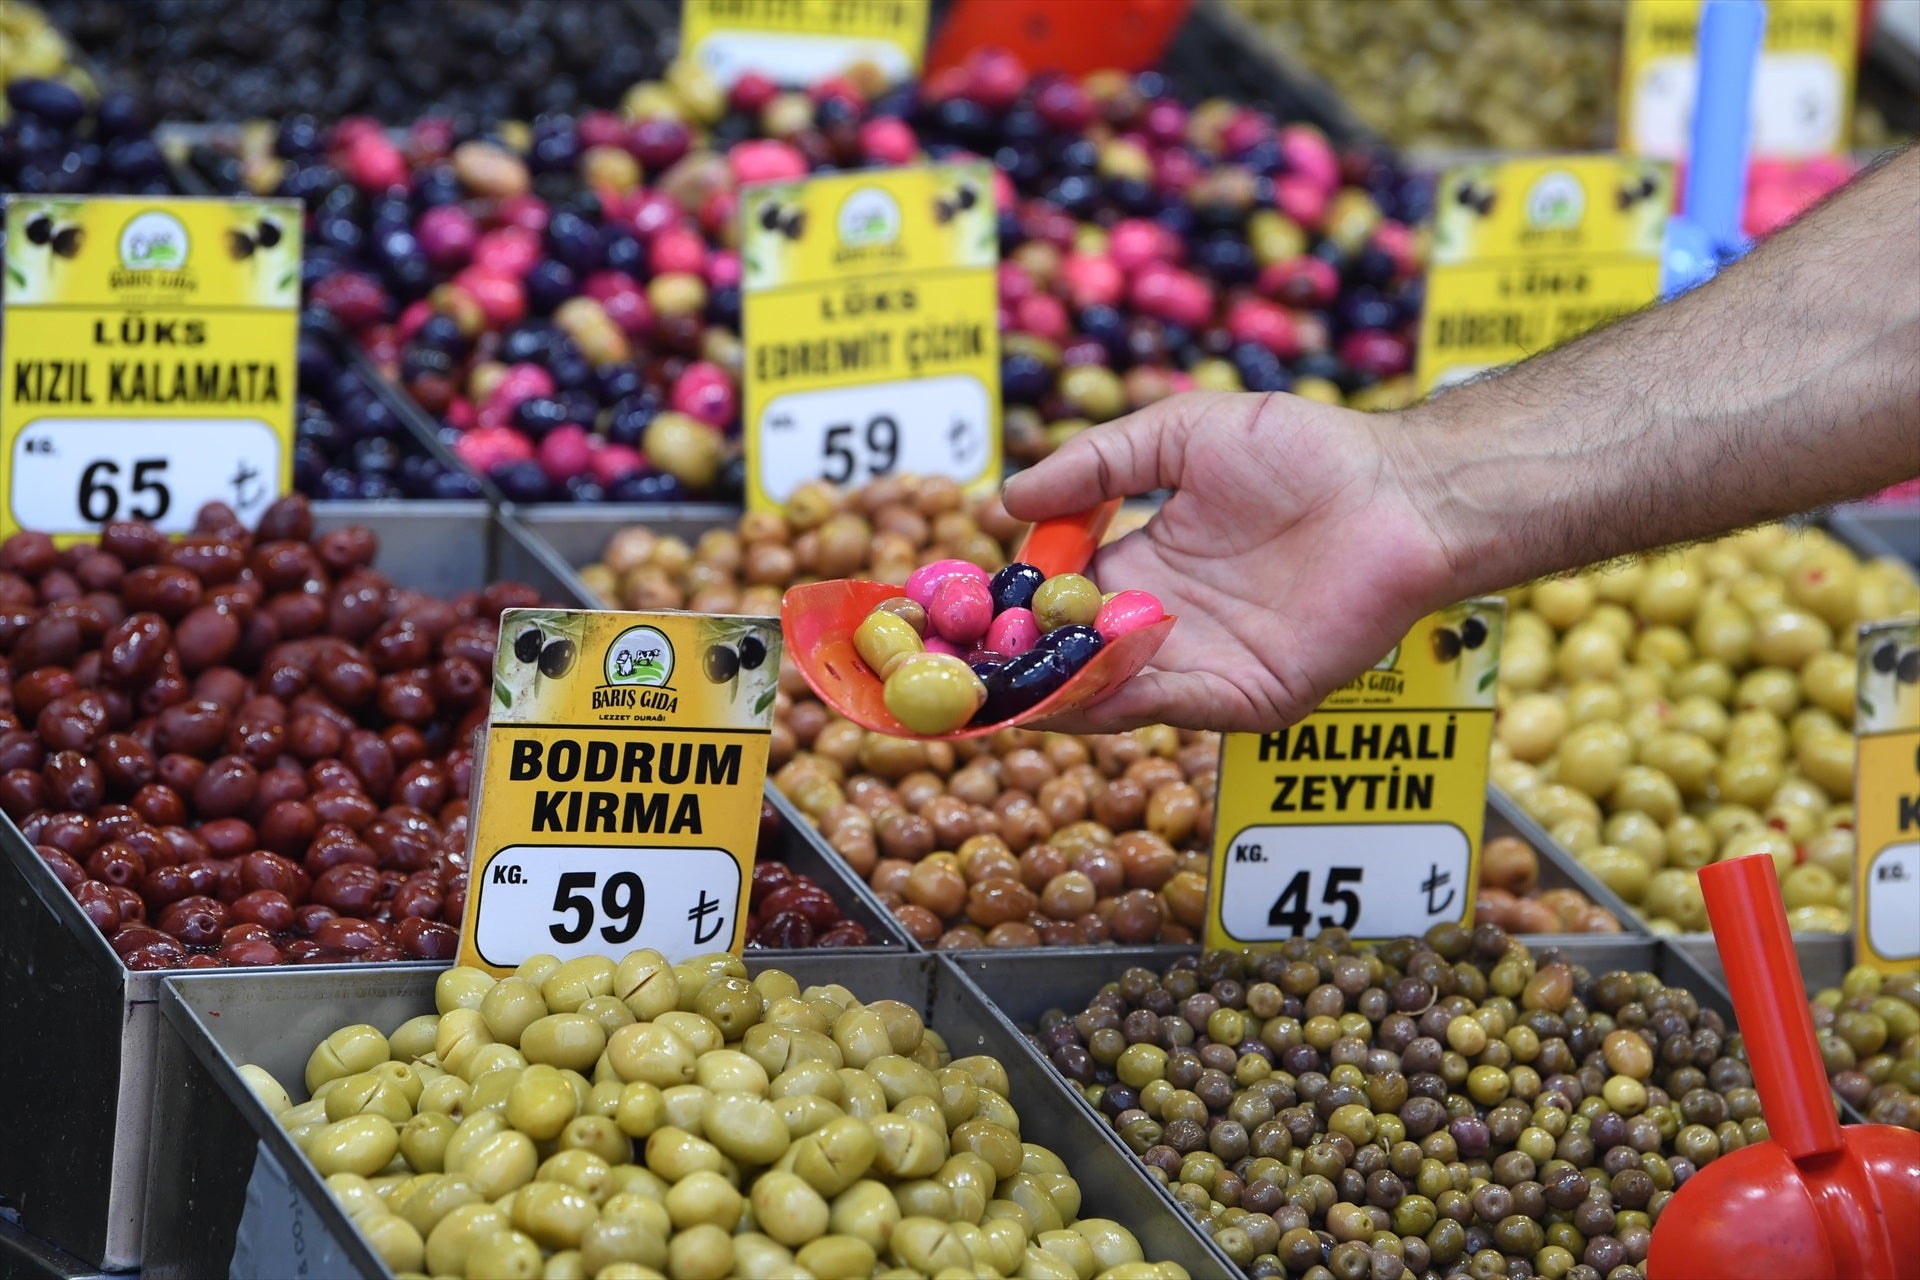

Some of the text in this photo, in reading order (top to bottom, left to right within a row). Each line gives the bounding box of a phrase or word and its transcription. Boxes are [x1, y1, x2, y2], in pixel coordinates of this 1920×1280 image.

[820, 283, 919, 319] LÜKS
[94, 311, 207, 345] LÜKS
[15, 361, 280, 406] KIZIL KALAMATA
[821, 414, 900, 485] 59
[78, 459, 171, 524] 65
[592, 689, 678, 714] BARIŞ GIDA
[1257, 715, 1458, 761] HALHALİ
[509, 739, 743, 785] BODRUM
[1270, 766, 1435, 812] ZEYTİN
[531, 790, 703, 835] KIRMA
[493, 864, 528, 884] KG.
[1236, 844, 1268, 863] KG.
[549, 871, 646, 944] 59
[1267, 867, 1363, 937] 45
